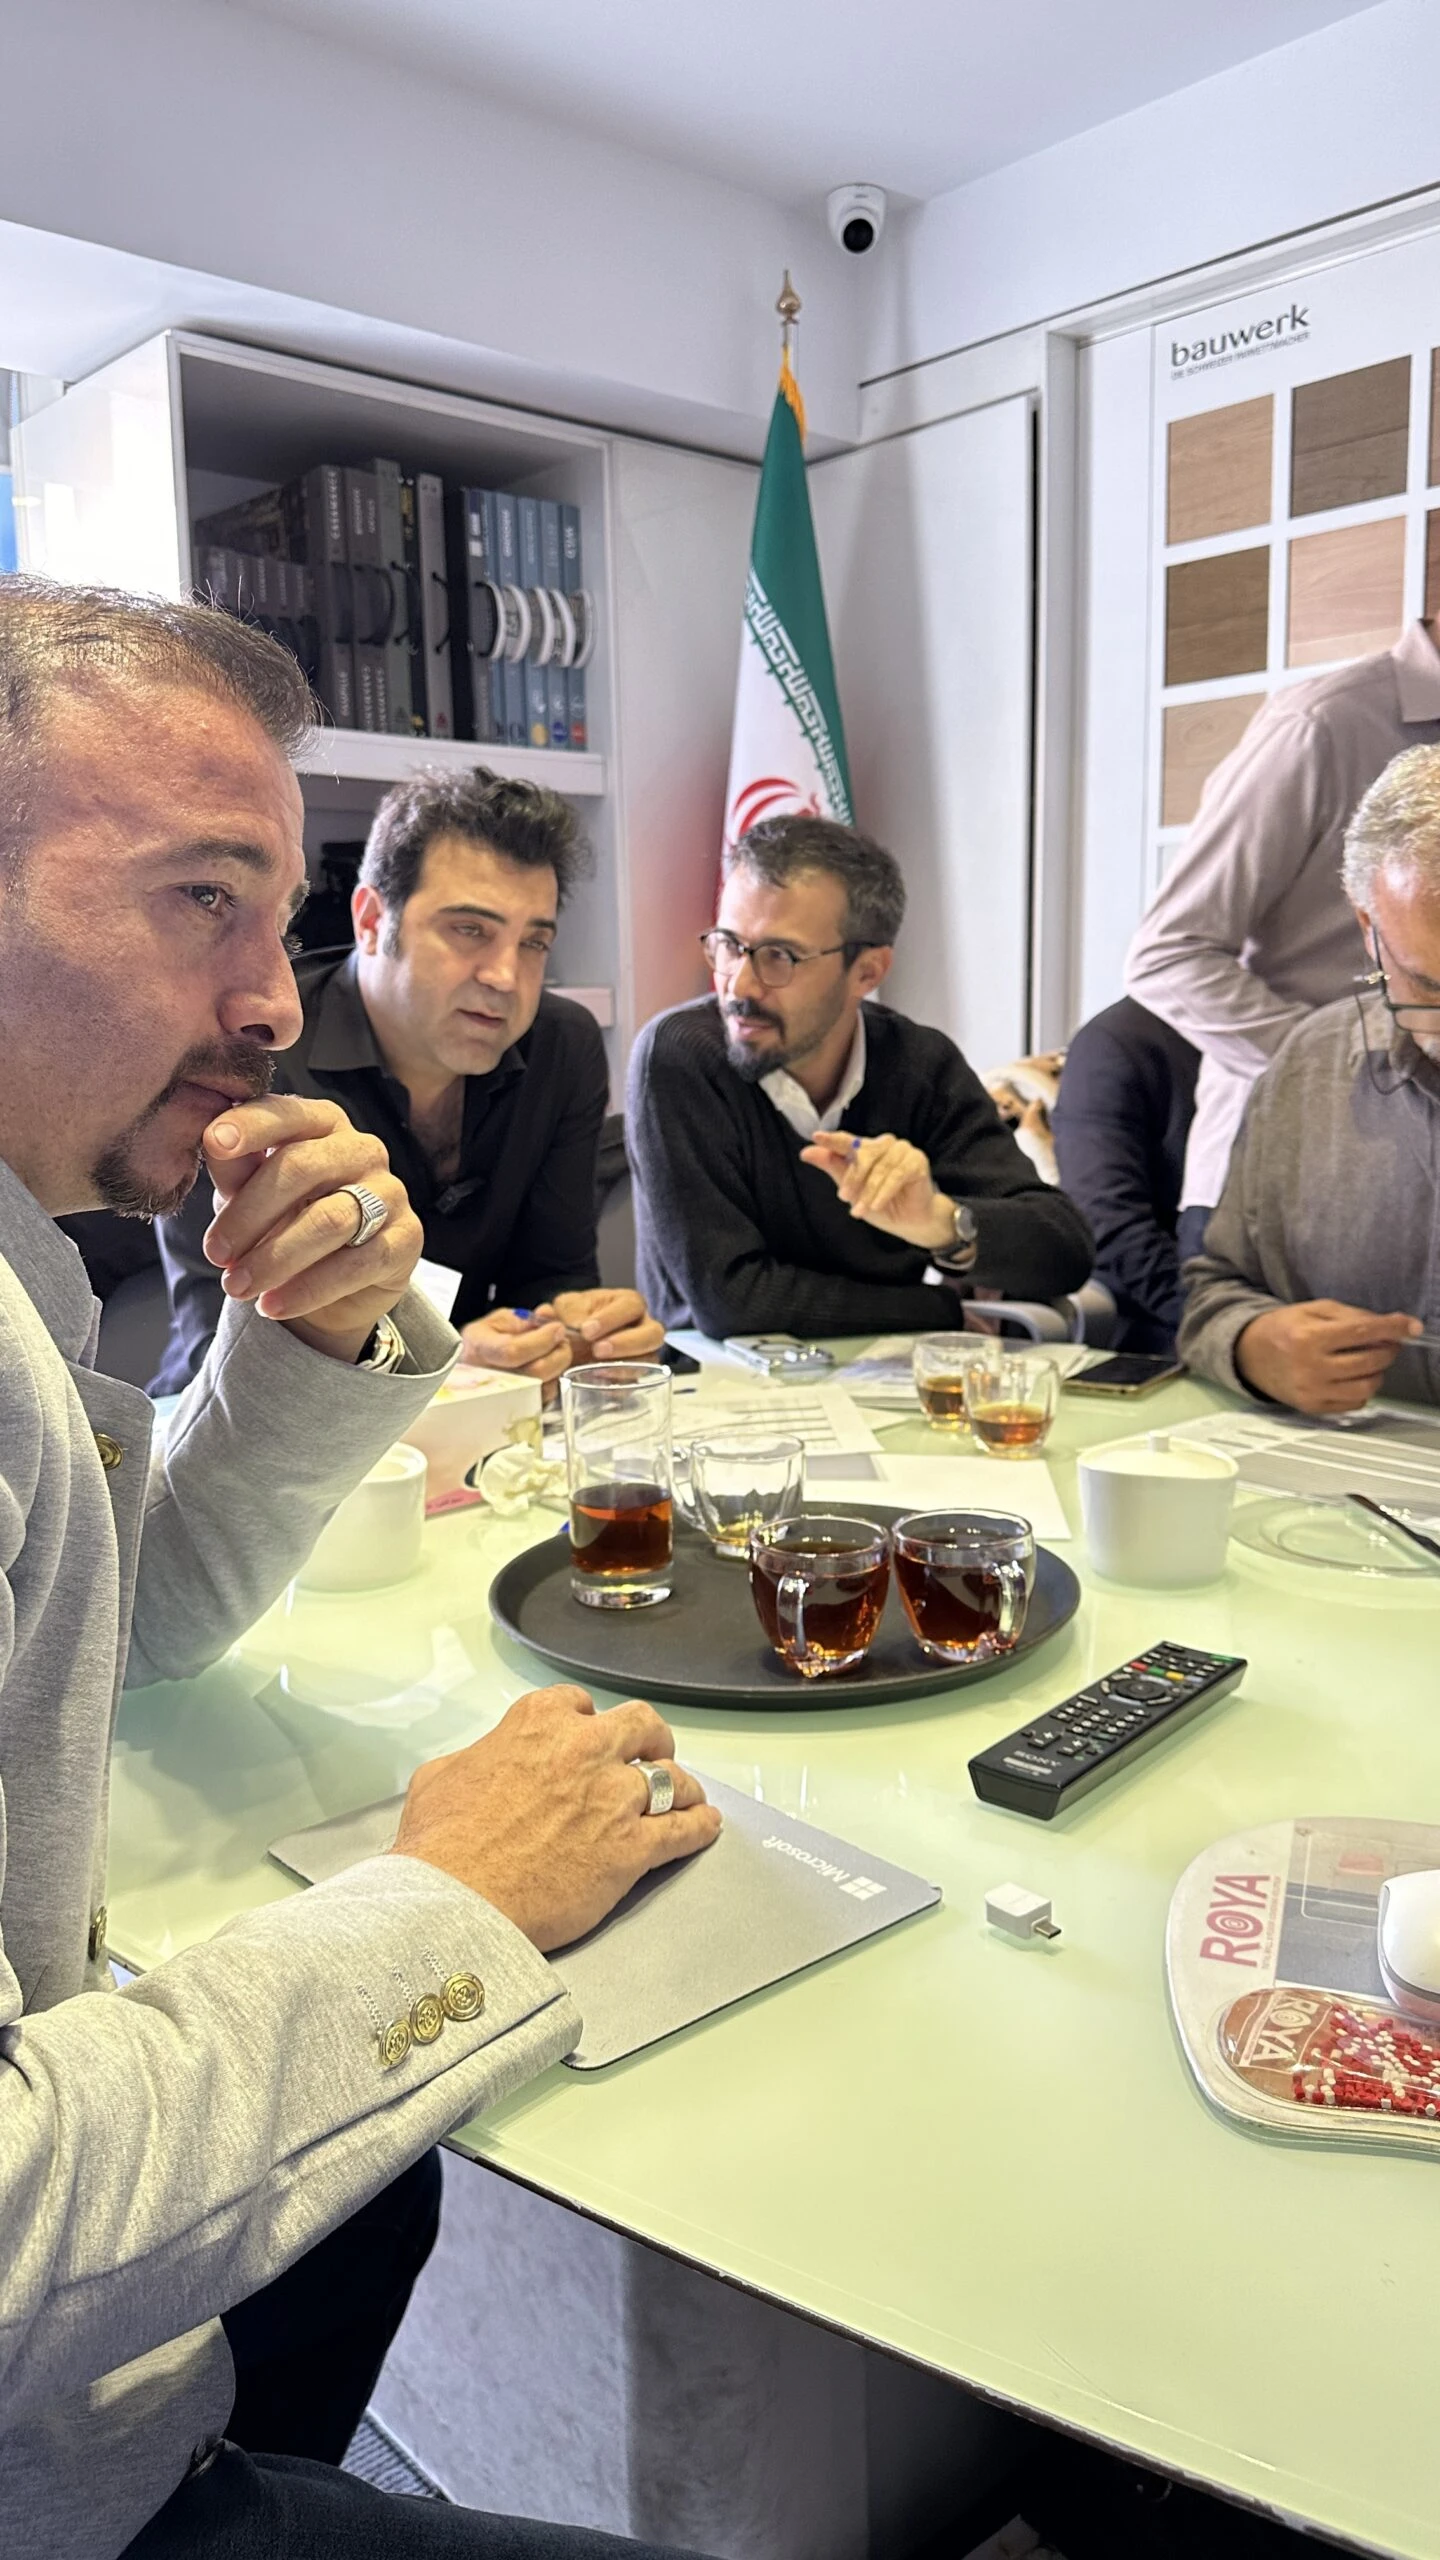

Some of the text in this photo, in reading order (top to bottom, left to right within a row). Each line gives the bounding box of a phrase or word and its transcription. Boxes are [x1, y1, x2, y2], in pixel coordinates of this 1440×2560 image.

[1171, 305, 1310, 367] bauwerk
[1014, 1750, 1061, 1767] SONY
[762, 1835, 850, 1883] Microsoft
[1200, 1874, 1271, 1967] ROYA
[1252, 1995, 1321, 2062] ROYA
